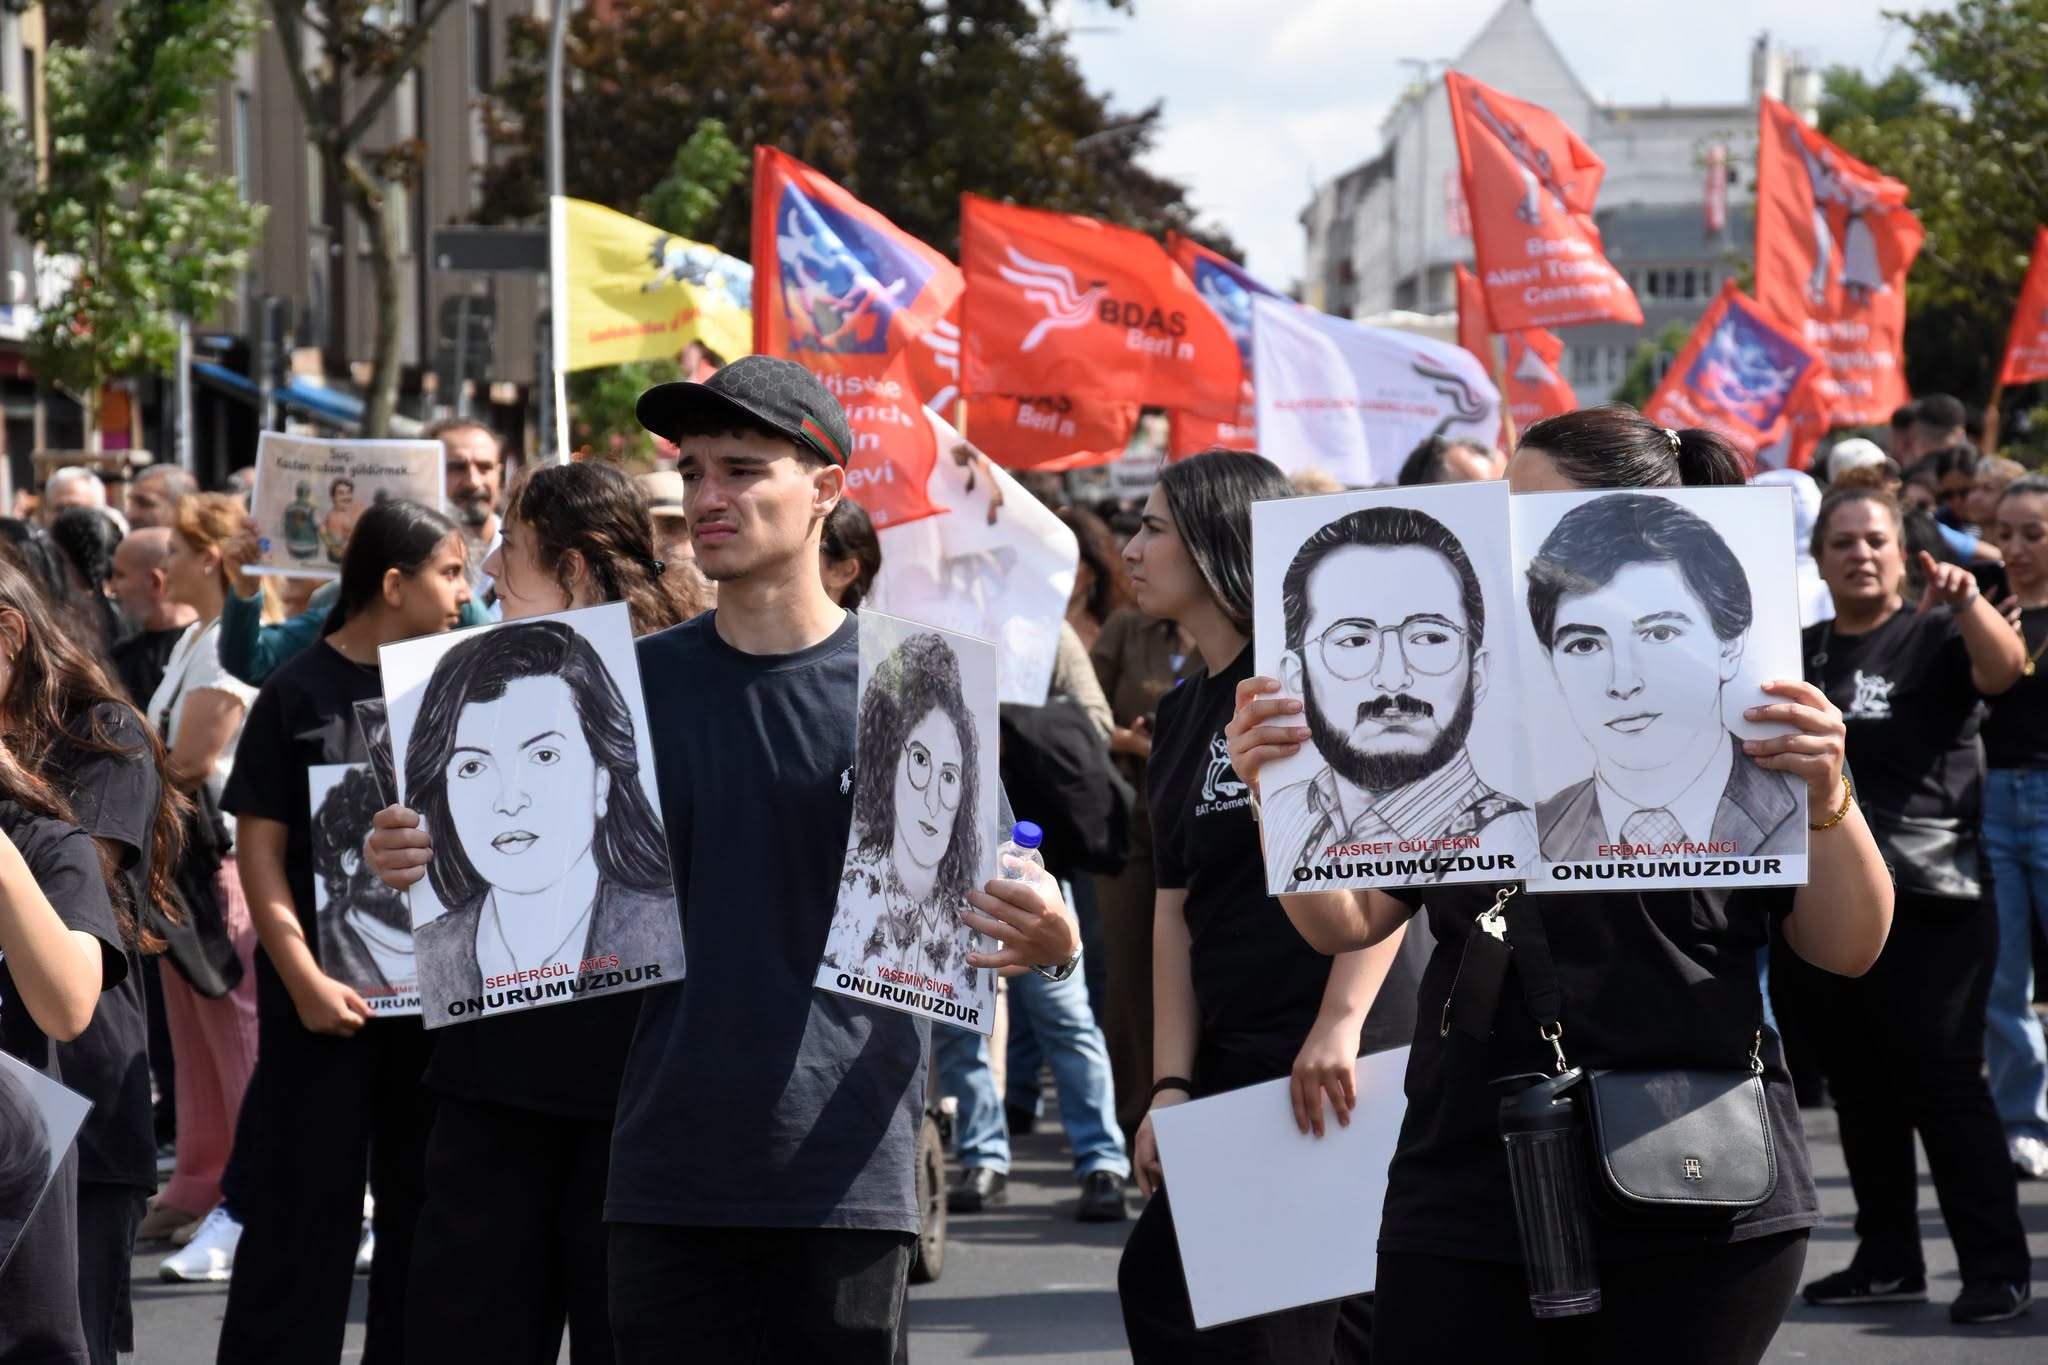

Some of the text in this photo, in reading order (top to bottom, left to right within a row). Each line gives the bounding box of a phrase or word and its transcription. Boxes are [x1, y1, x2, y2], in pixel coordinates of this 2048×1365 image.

[1099, 299, 1187, 338] BDAS
[1326, 834, 1480, 858] HASRET GÜLTEKİN
[1598, 839, 1738, 857] ERDAL AYRANCI
[1293, 854, 1517, 882] ONURUMUZDUR
[1551, 858, 1782, 881] ONURUMUZDUR
[485, 953, 621, 990] SEHERGÜL ATEŞ
[876, 965, 925, 990] YASEMİN
[447, 963, 664, 1017] ONURUMUZDUR
[836, 973, 980, 1026] ONURUMUZDUR
